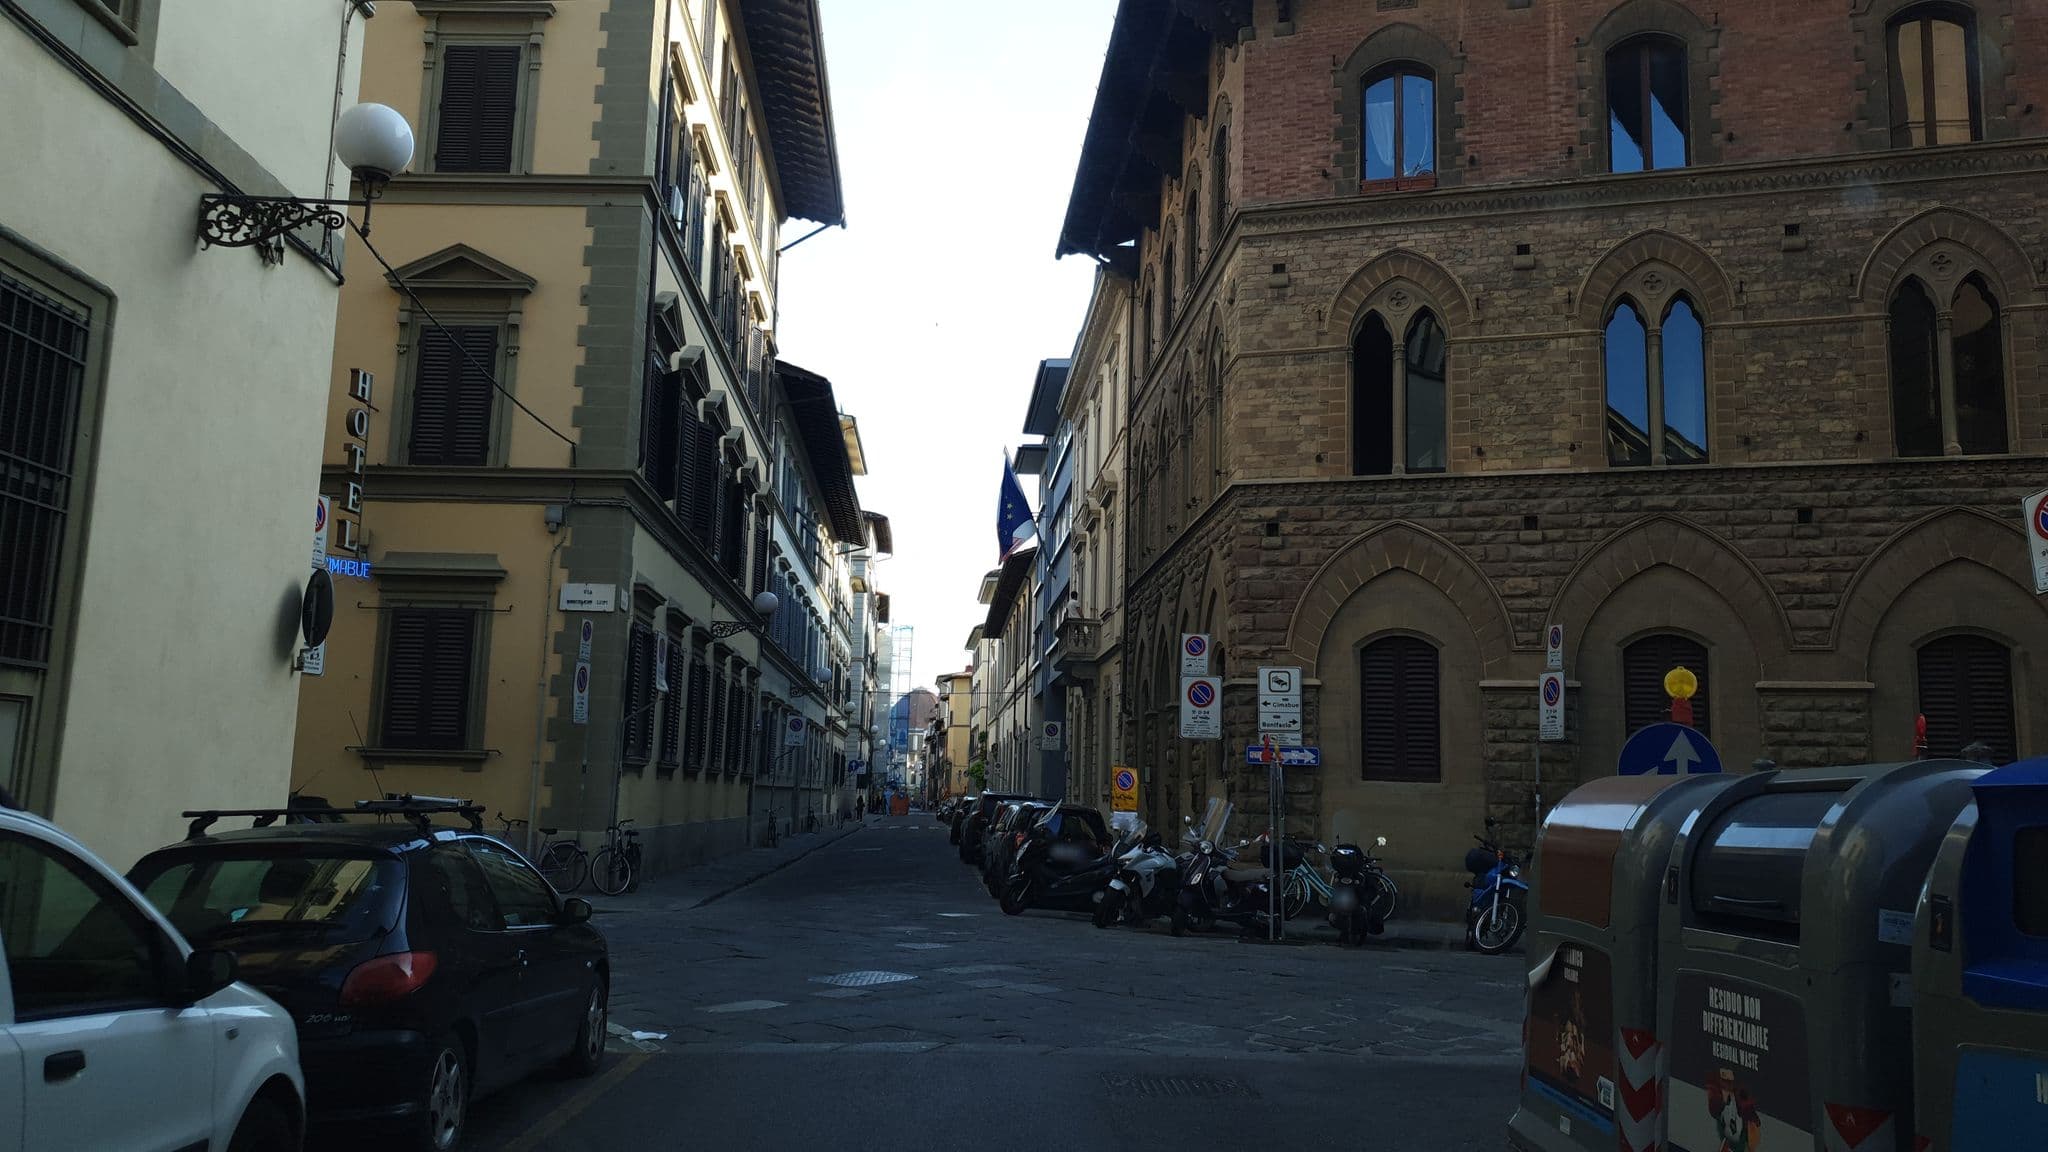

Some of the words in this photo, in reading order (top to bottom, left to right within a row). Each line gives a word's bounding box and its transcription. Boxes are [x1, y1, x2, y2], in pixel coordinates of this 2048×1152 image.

[337, 368, 373, 551] HOTEL
[325, 555, 371, 578] IMABUE
[1709, 986, 1742, 1015] RESIDUO
[1744, 995, 1761, 1021] NON
[1703, 1010, 1769, 1052] DIFFERENZIABILE
[1712, 1041, 1739, 1065] RESIDUAL
[1739, 1049, 1759, 1072] WASTE
